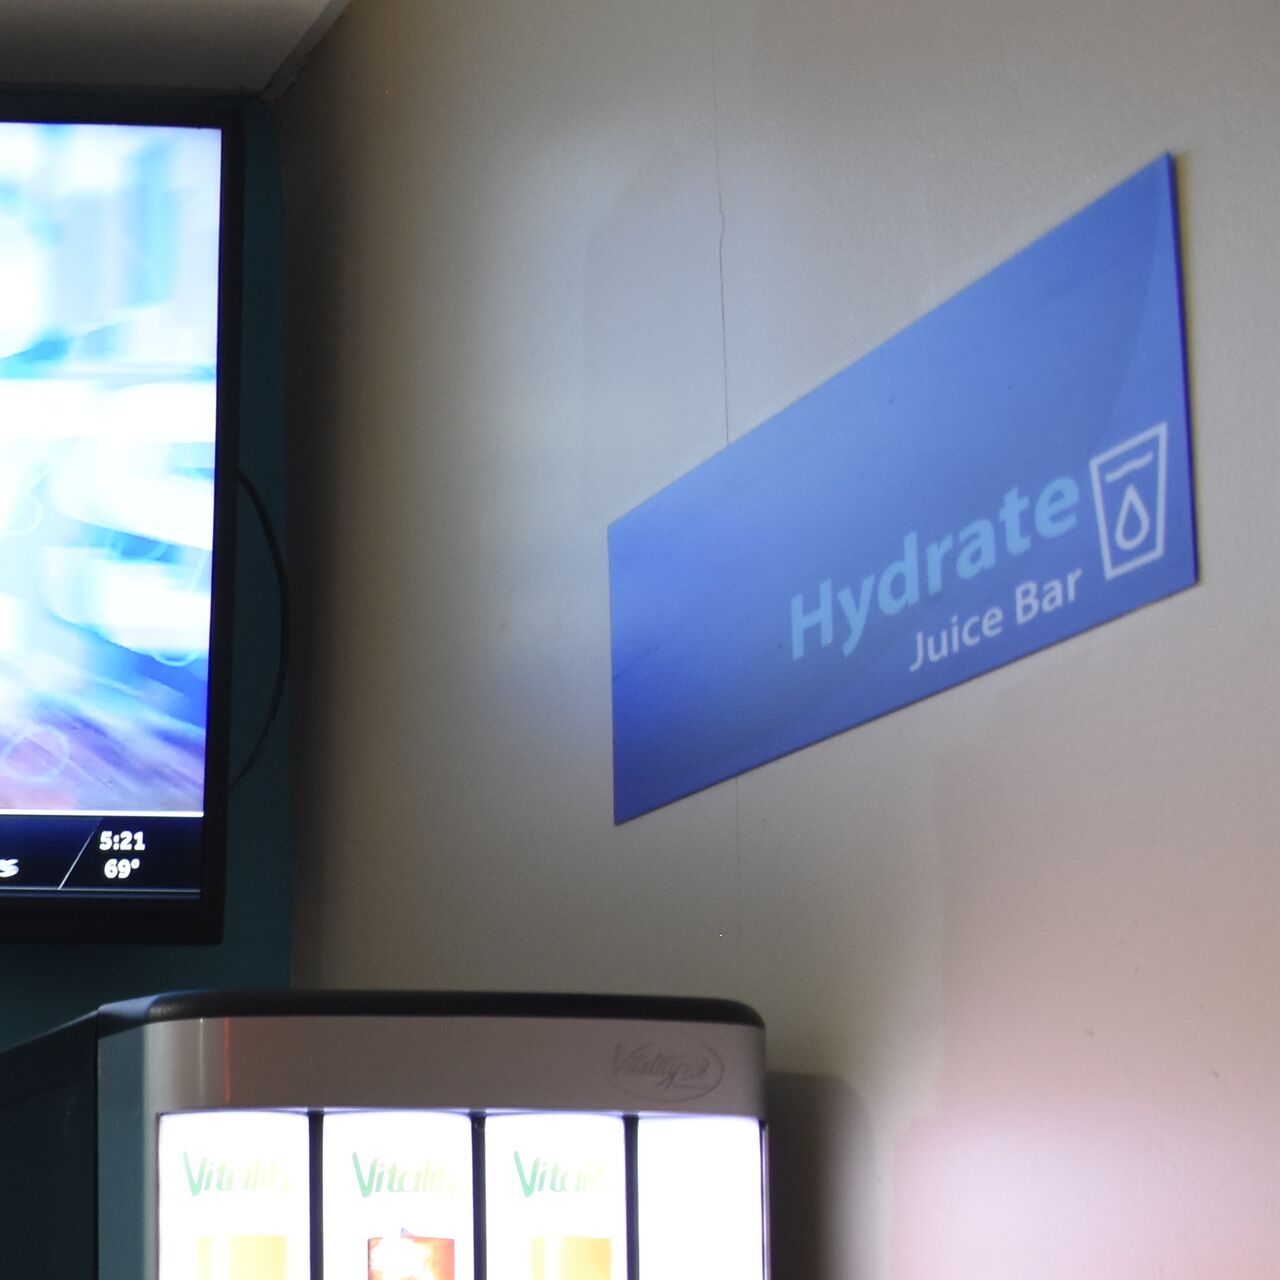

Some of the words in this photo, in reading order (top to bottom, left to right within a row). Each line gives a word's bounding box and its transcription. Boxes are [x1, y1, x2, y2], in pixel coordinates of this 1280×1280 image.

[790, 475, 1080, 661] Hydrate
[908, 605, 1004, 673] Juice
[1014, 567, 1084, 626] Bar
[99, 830, 146, 851] 5:21
[104, 858, 141, 879] 69°
